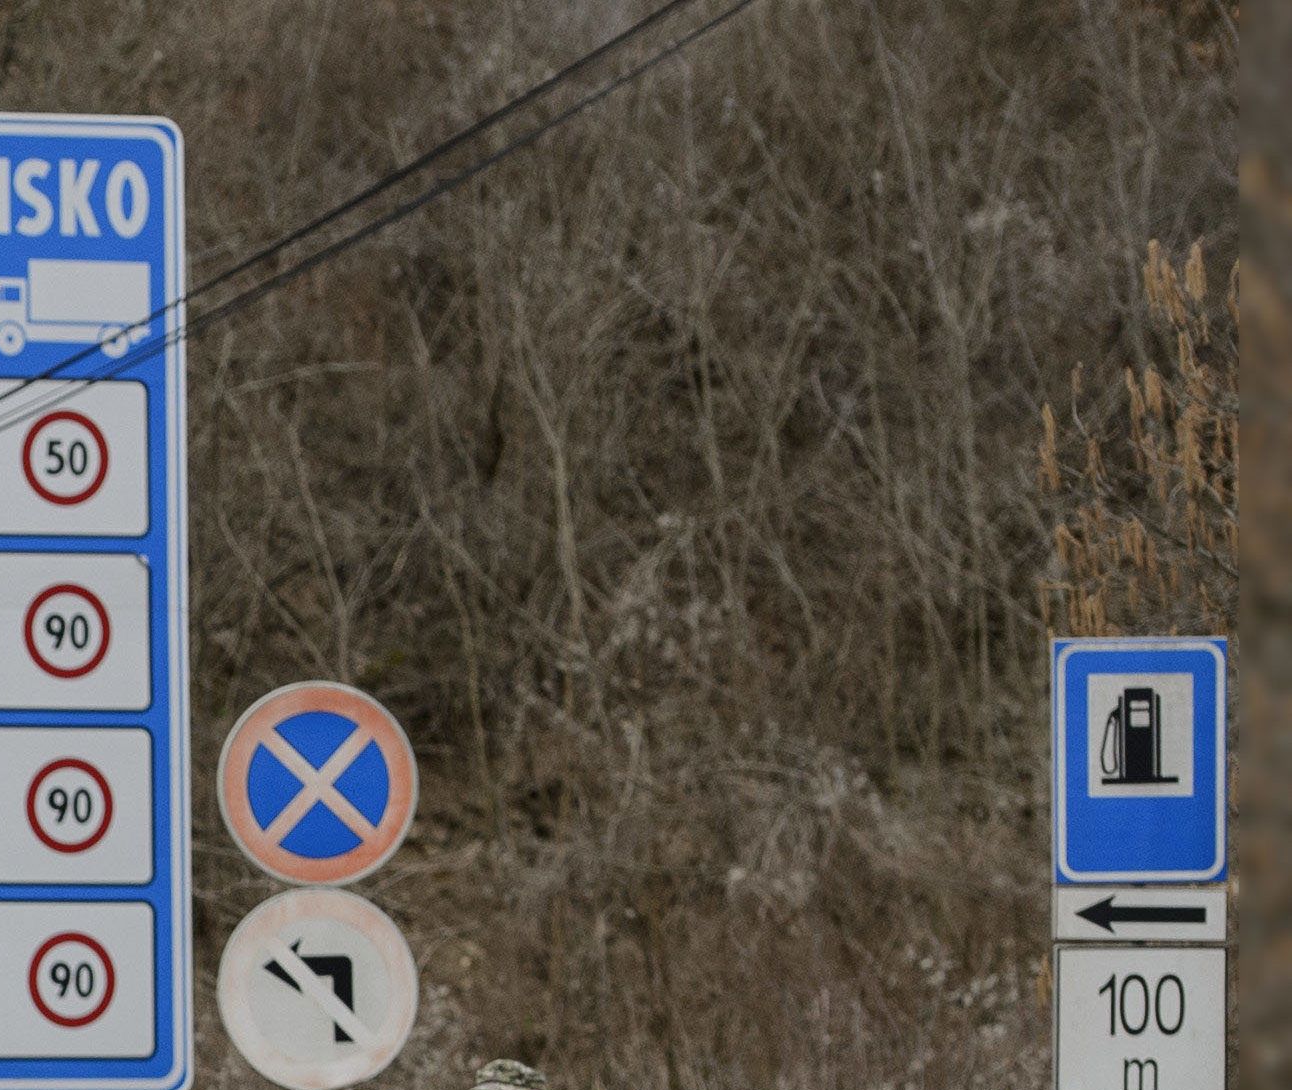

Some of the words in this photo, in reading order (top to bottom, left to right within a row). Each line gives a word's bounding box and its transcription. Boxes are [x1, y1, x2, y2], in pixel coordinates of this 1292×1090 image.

[46, 440, 88, 476] 50
[45, 614, 89, 650] 90
[48, 787, 93, 825] 90
[50, 962, 94, 999] 90
[1098, 972, 1185, 1037] 100
